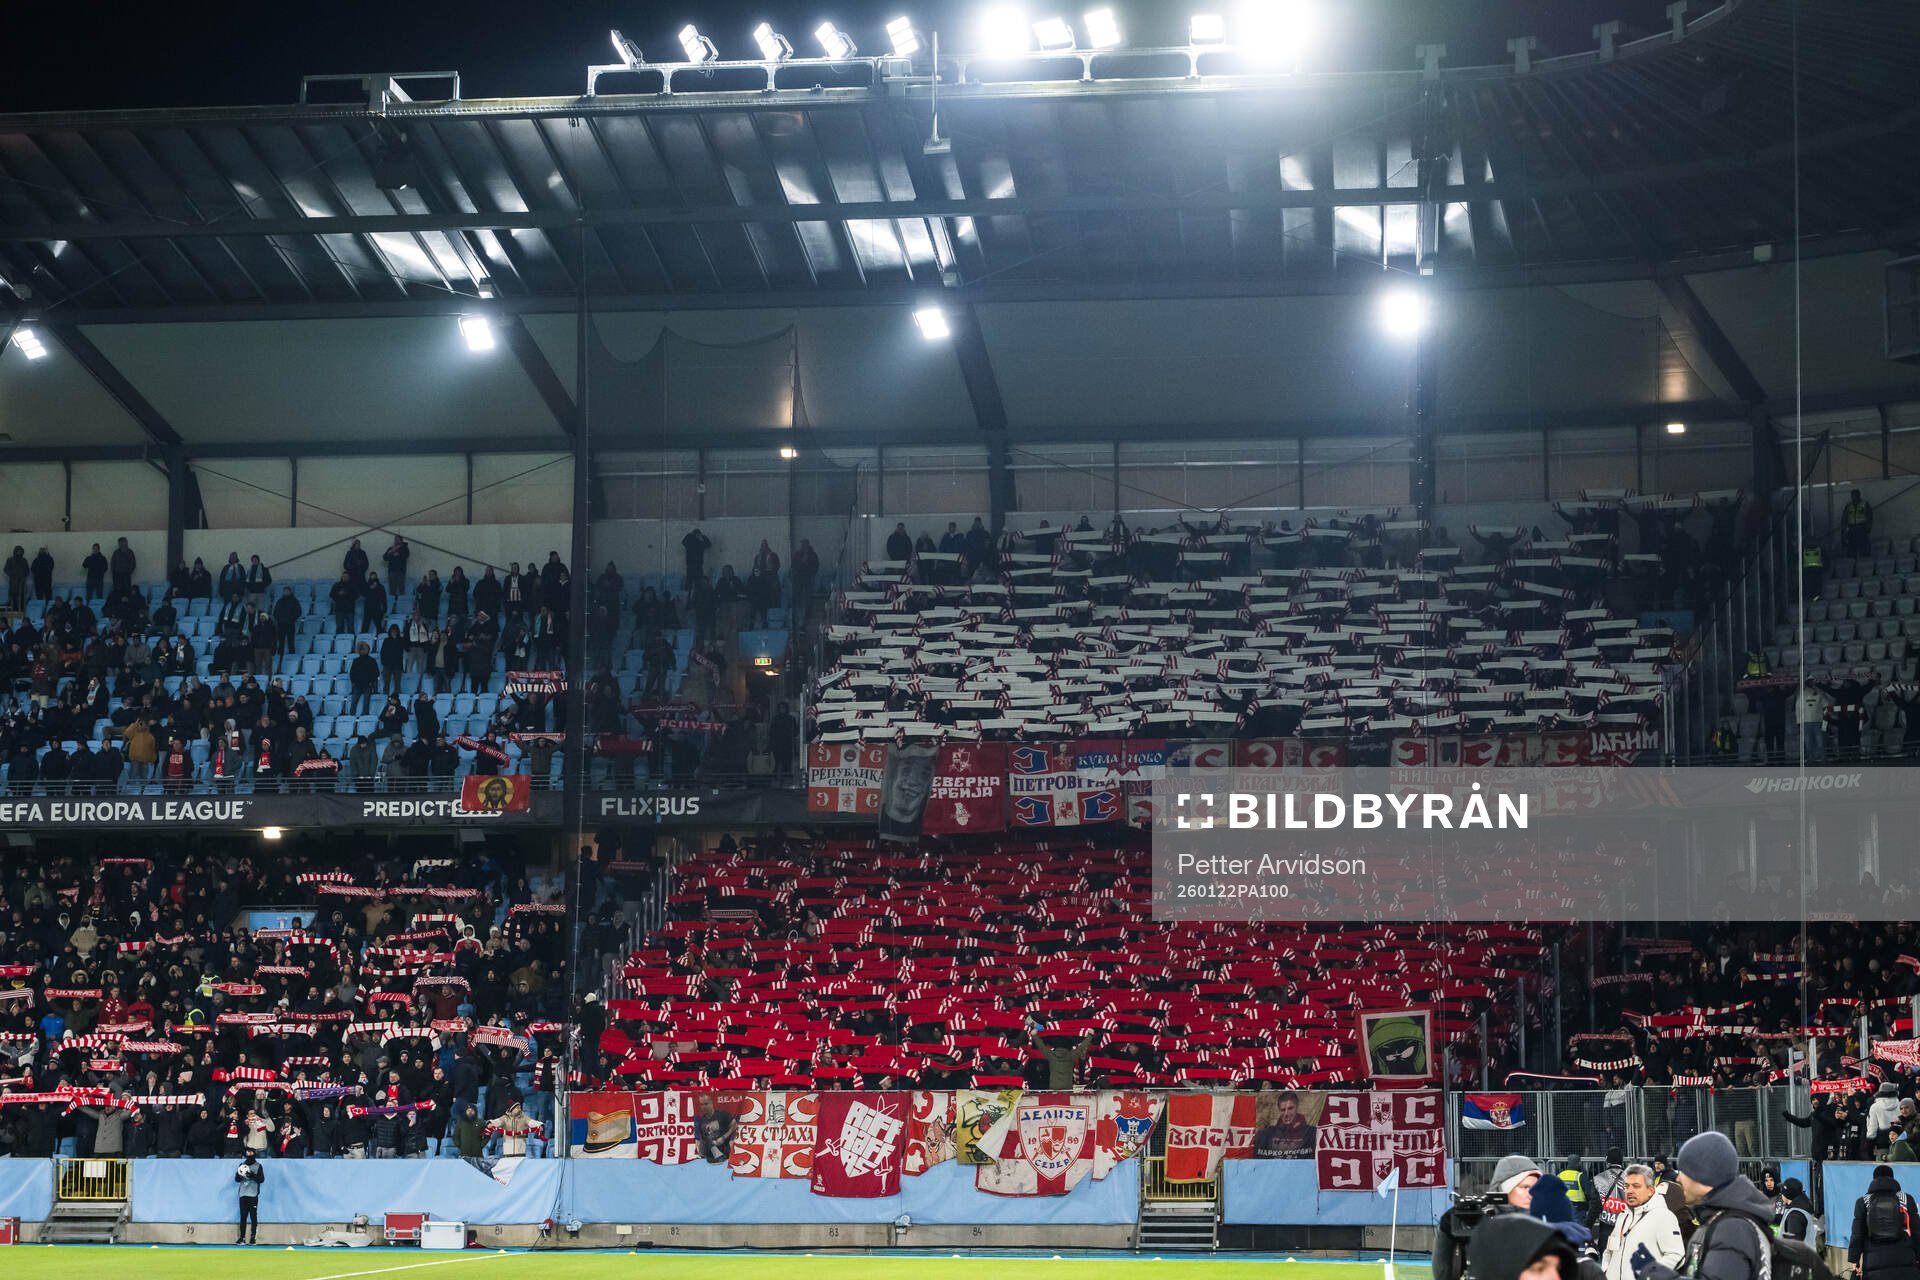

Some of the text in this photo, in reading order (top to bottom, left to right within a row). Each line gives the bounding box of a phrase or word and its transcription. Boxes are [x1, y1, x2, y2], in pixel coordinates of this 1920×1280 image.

[810, 768, 885, 783] РЕПУБЛИКА
[828, 778, 868, 787] СРПСКА
[932, 776, 1001, 788] ЕВЕРНА
[0, 803, 44, 822] EFA
[50, 801, 145, 822] EUROPA
[1020, 1108, 1086, 1122] ДЕЛИЈЕ
[637, 1124, 695, 1138] ORTHODO
[1168, 1128, 1256, 1147] BRIGAT
[1027, 1136, 1079, 1145] 19 89
[1033, 1157, 1070, 1169] СЕВЕР
[1601, 1197, 1627, 1212] POTO
[972, 1227, 982, 1236] 84
